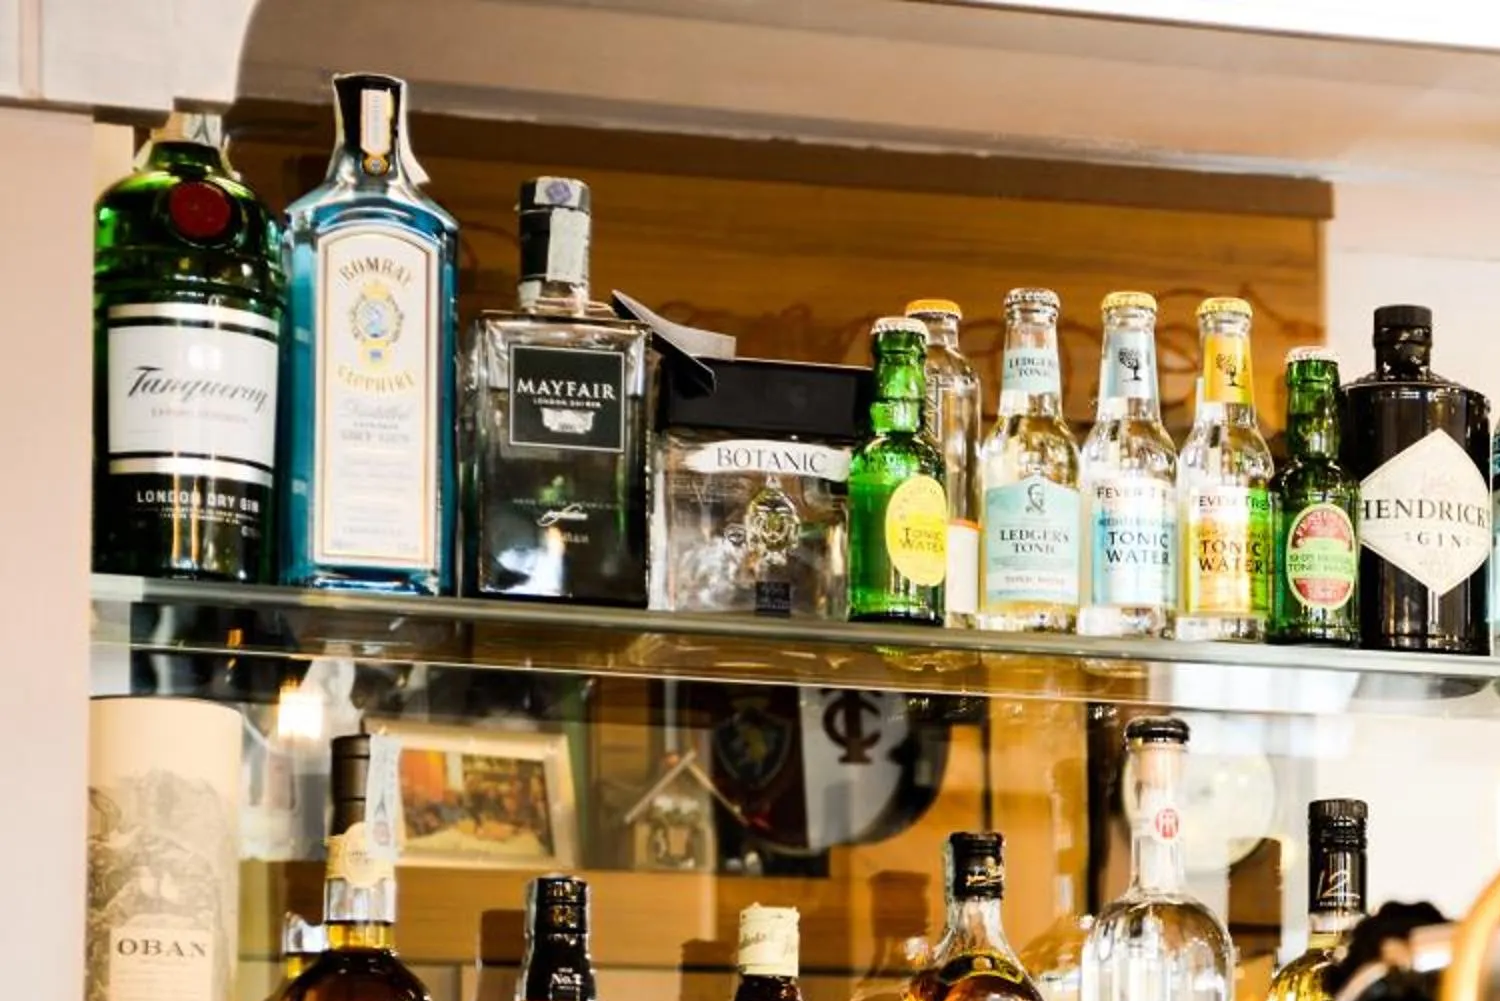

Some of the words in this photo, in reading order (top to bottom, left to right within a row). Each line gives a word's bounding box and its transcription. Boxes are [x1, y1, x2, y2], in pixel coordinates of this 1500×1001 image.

[127, 365, 269, 415] Tanqueray
[516, 377, 617, 401] MAYFAIR
[716, 447, 827, 473] BOTANIC
[1108, 531, 1169, 549] TONIC
[1200, 539, 1263, 557] TONIC
[1417, 530, 1461, 548] GIN
[1105, 548, 1171, 566] WATER
[1198, 557, 1264, 575] WATER
[117, 937, 208, 957] OBAN
